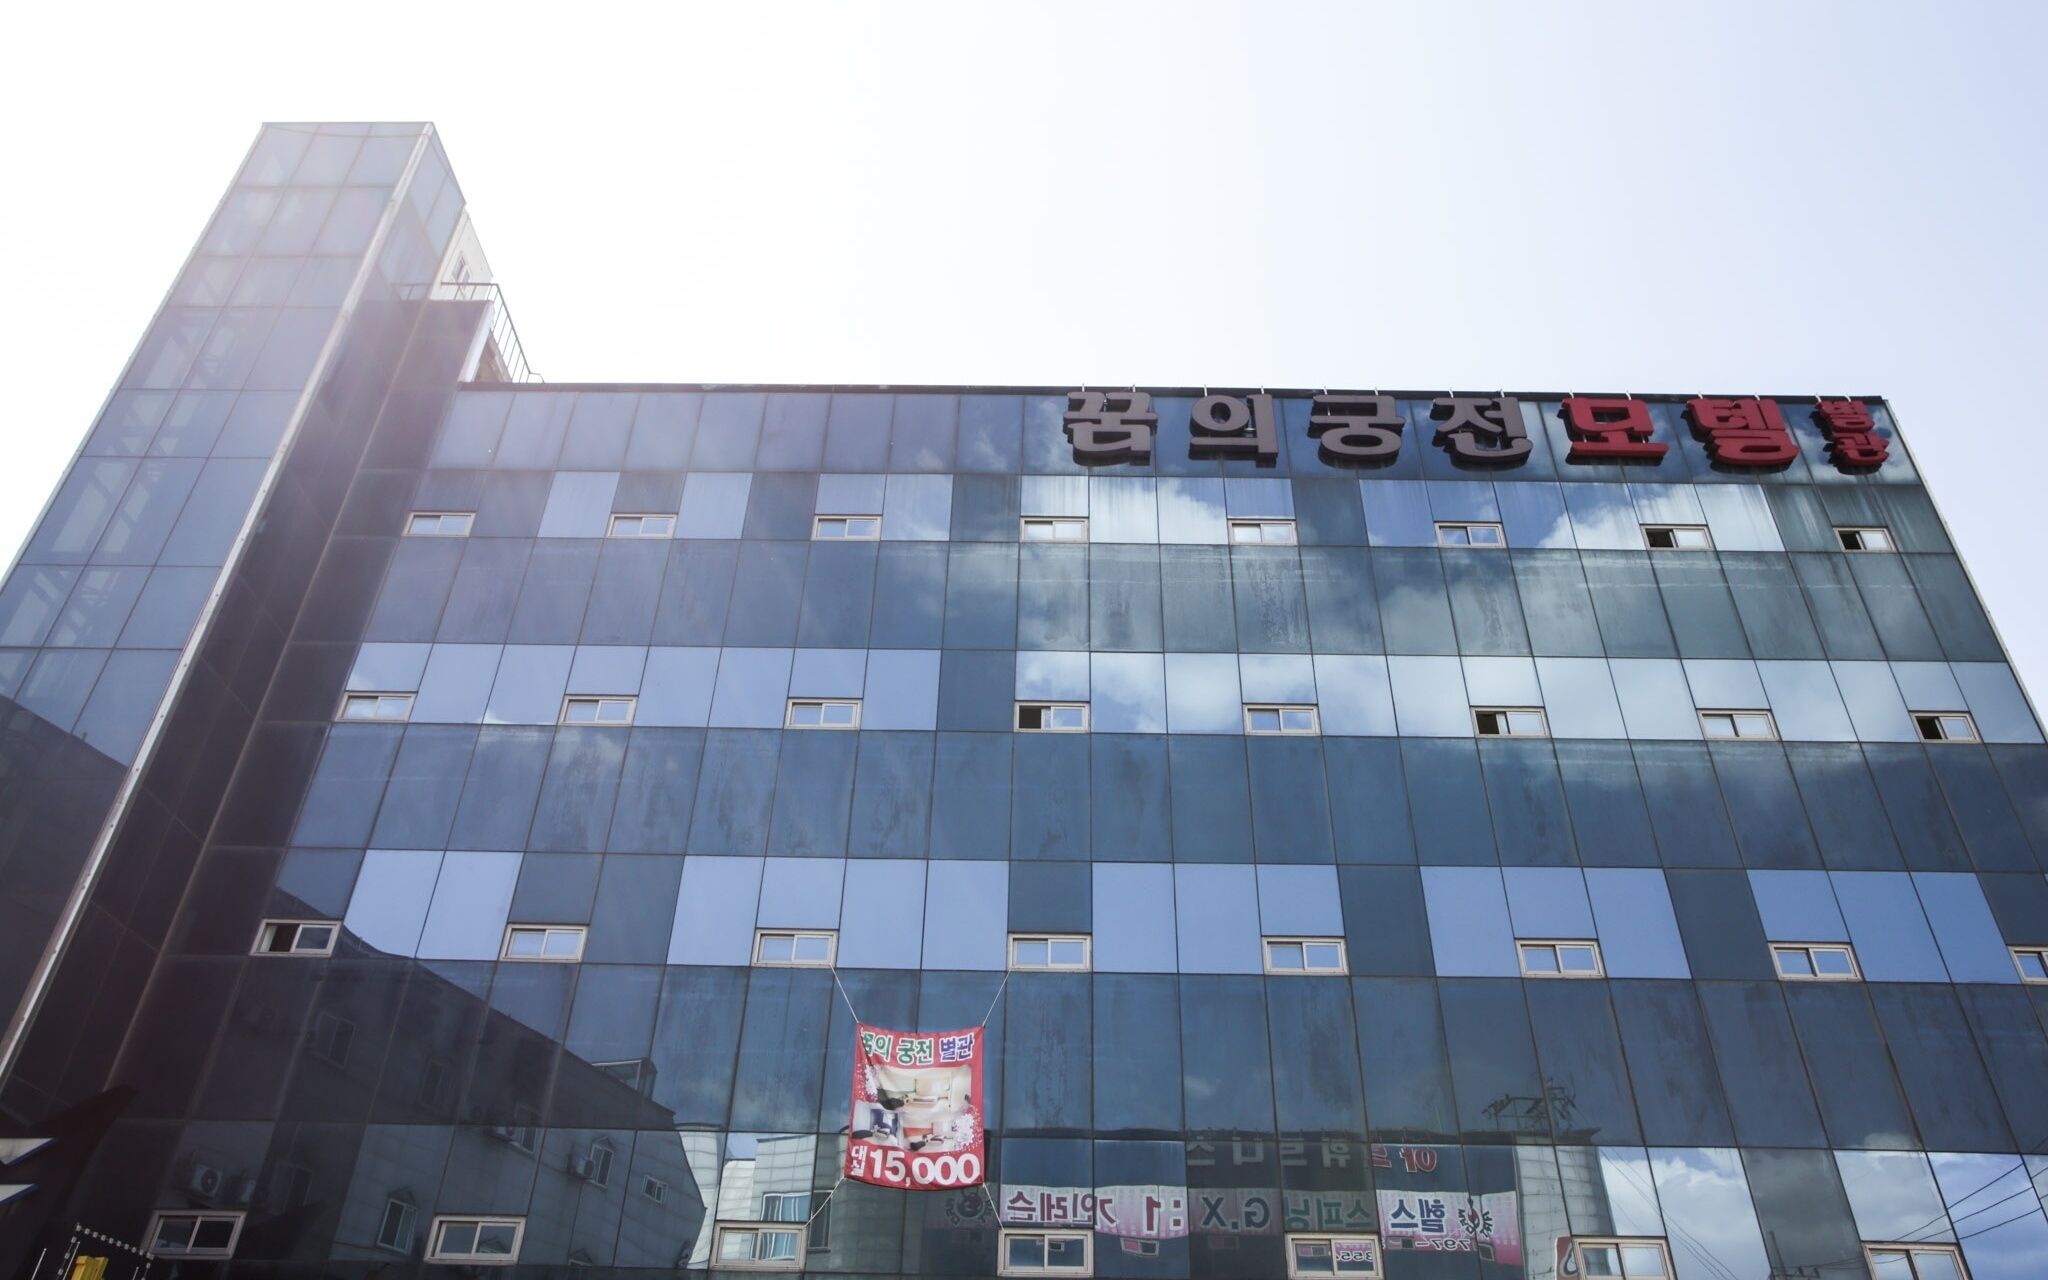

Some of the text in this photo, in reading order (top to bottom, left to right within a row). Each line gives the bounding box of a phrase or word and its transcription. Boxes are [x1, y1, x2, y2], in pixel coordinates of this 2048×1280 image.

[1561, 397, 1799, 465] 모텔
[898, 1037, 934, 1065] 궁전
[939, 1033, 975, 1062] 별관
[851, 1145, 981, 1188] 대실 15,000
